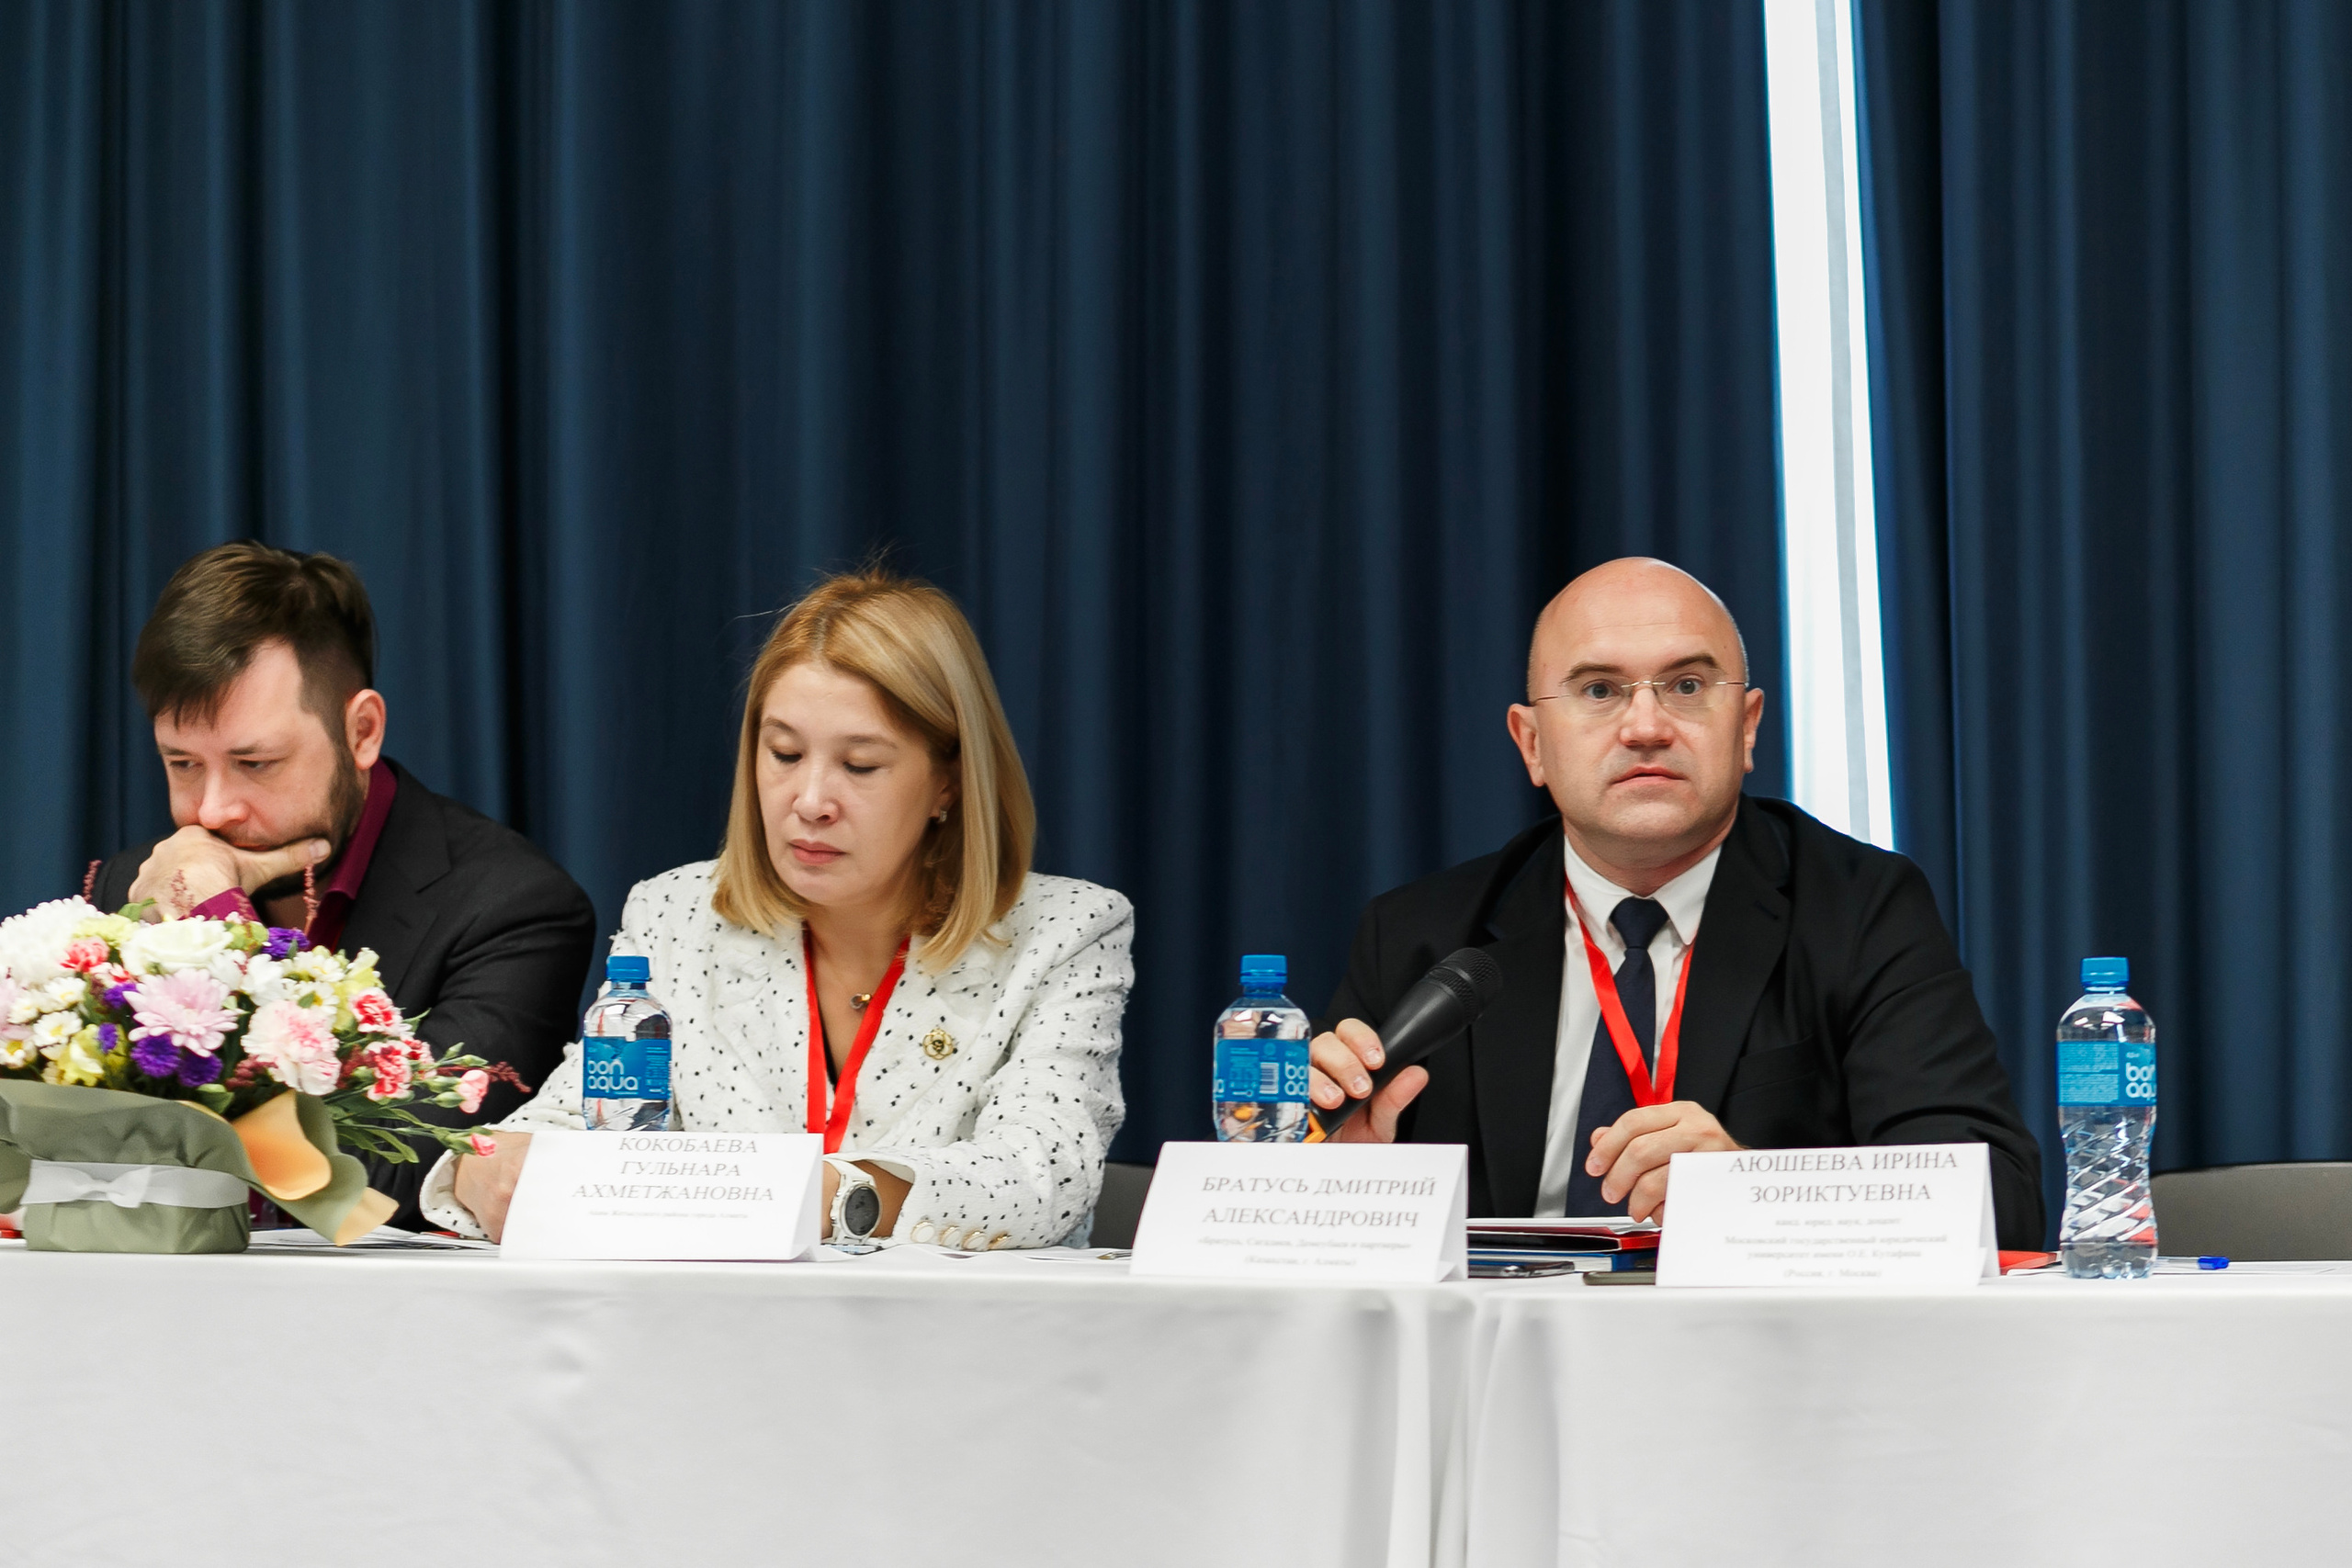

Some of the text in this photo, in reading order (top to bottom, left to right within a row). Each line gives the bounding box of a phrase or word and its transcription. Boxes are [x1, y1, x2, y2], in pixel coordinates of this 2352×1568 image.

[587, 1075, 639, 1093] aqua
[617, 1137, 759, 1155] КОКОБАЕВА
[619, 1160, 742, 1178] ГУЛЬНАРА
[1729, 1151, 1959, 1174] АЮШЕЕВА ИРИНА
[571, 1183, 775, 1202] АХМЕТЖАНОВНА
[1200, 1176, 1438, 1197] БРАТУСЬ ДМИТРИЙ
[1748, 1182, 1933, 1204] ЗОРИКТУЕВНА
[1201, 1207, 1420, 1229] АЛЕКСАНДРОВИЧ
